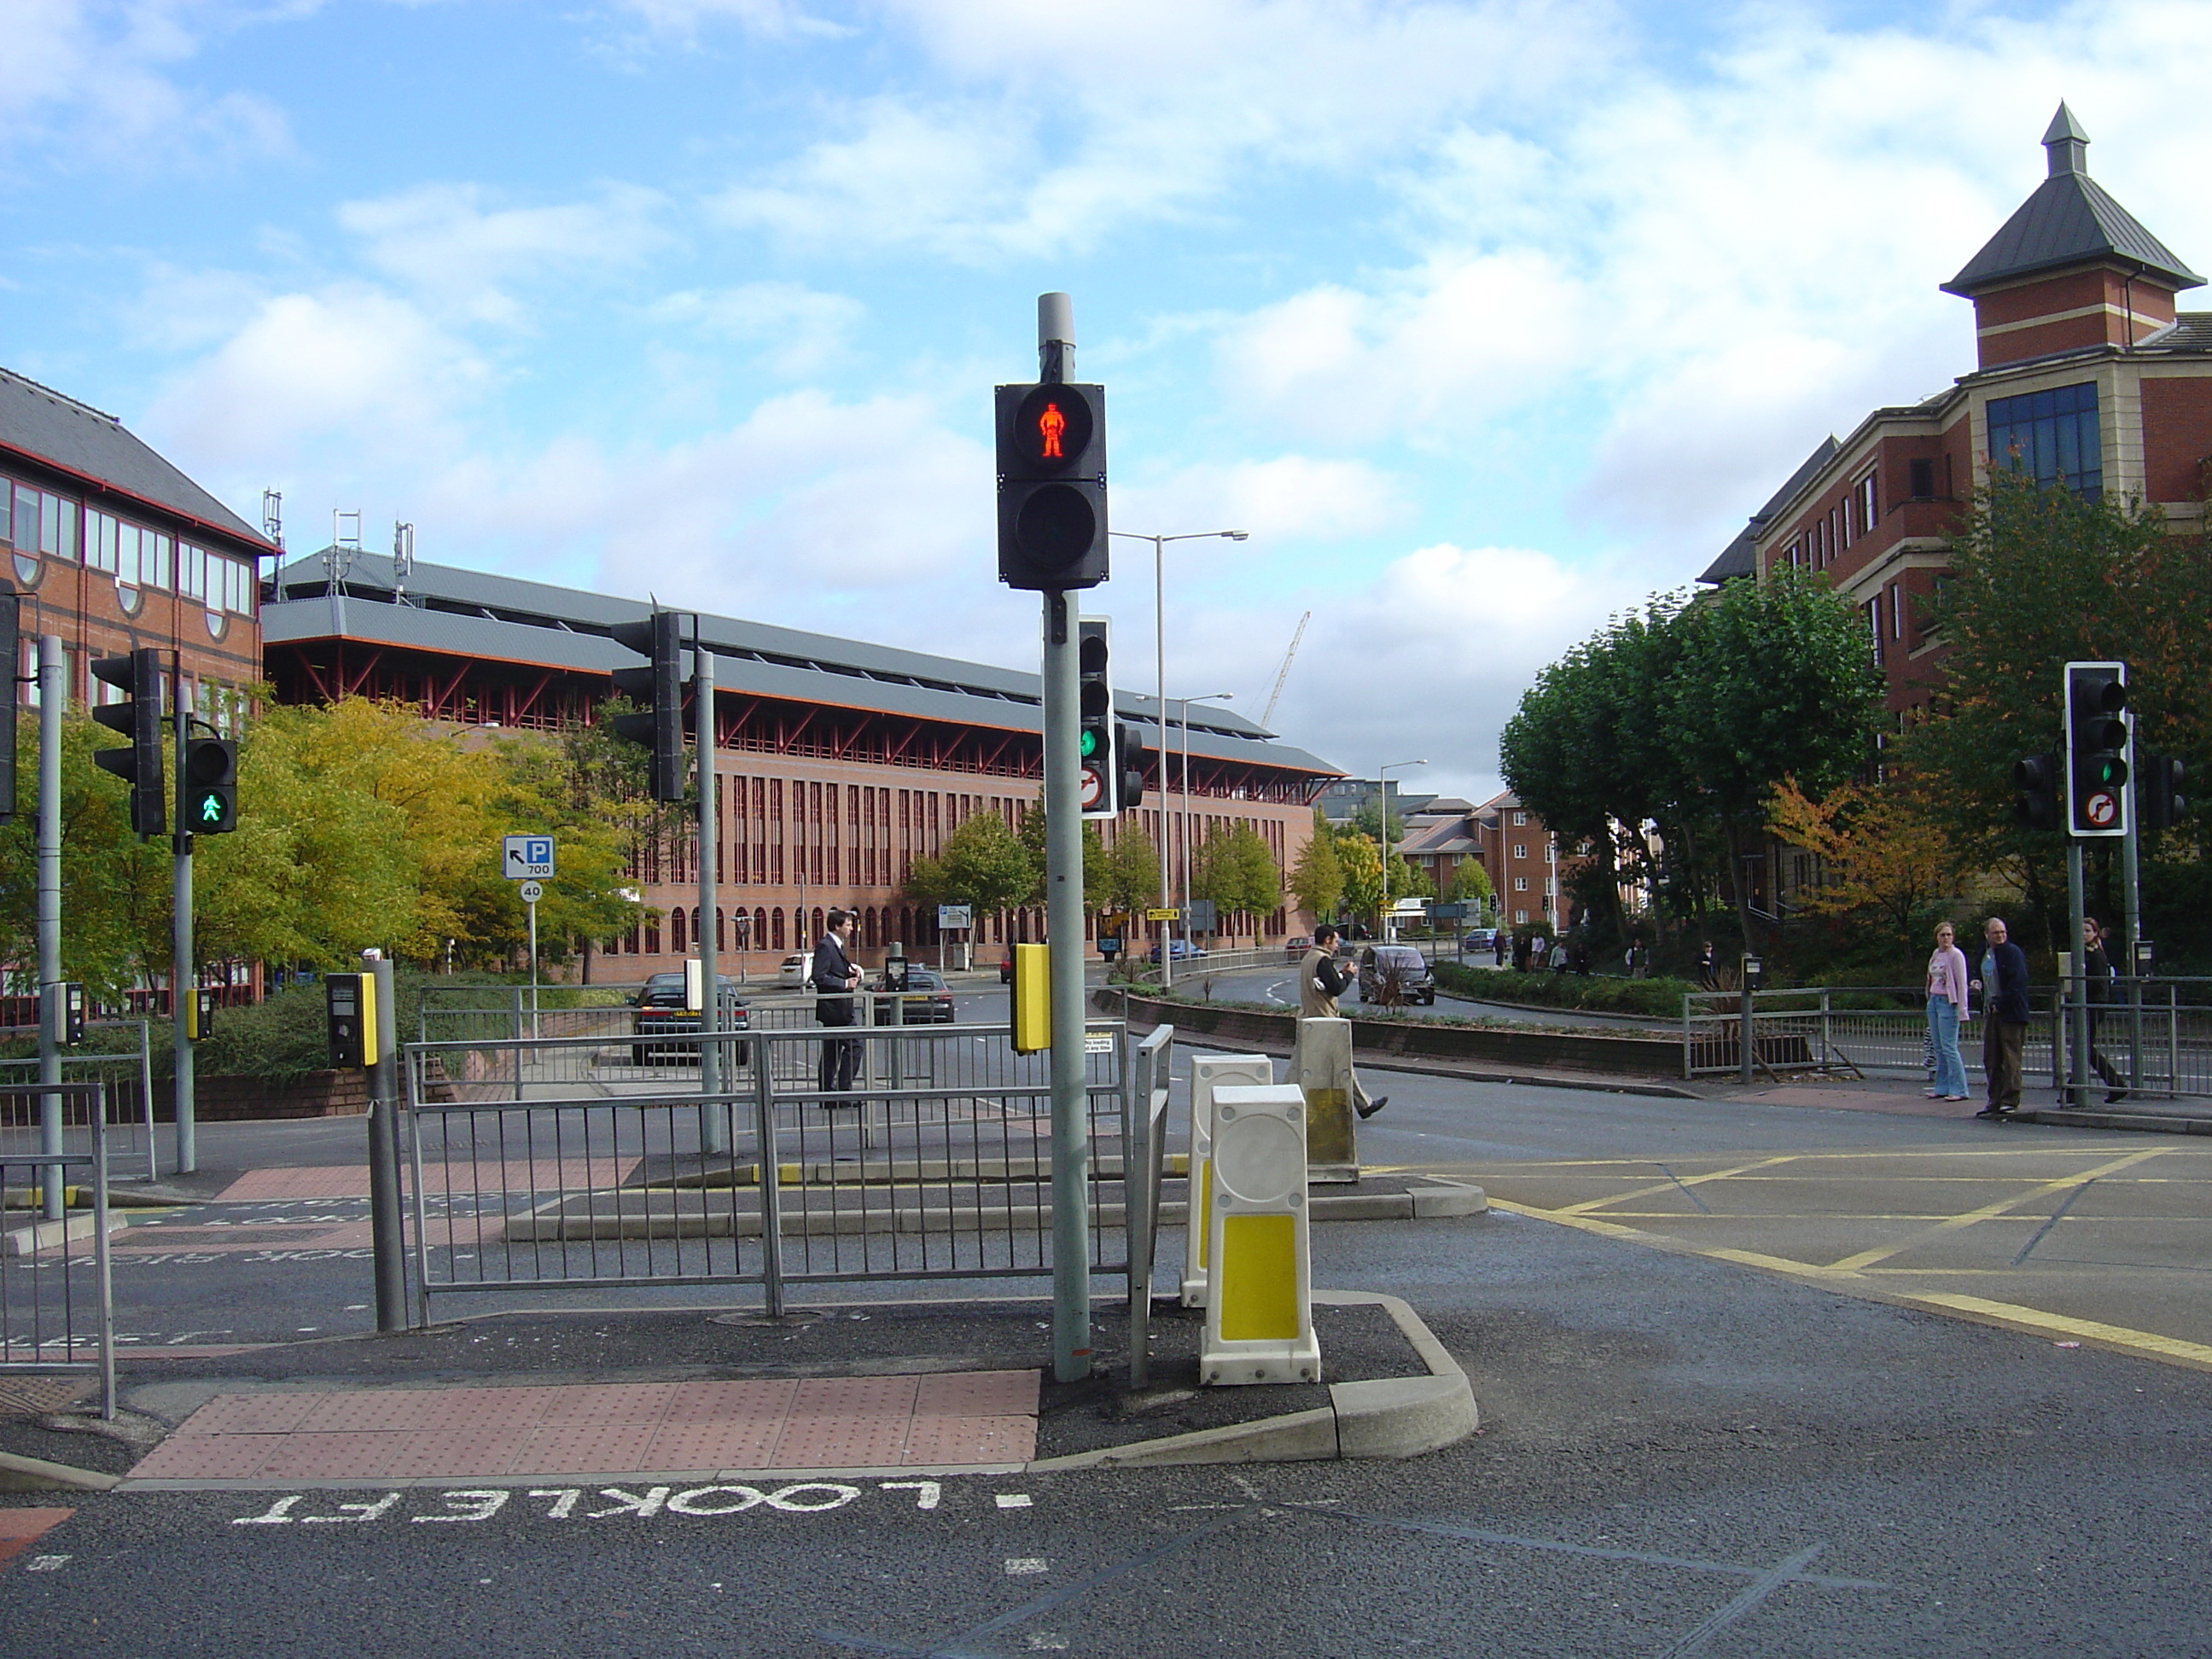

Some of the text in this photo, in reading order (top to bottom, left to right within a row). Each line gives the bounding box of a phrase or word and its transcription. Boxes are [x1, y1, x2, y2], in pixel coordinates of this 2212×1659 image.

[532, 843, 546, 862] P
[528, 865, 550, 874] 700
[524, 888, 540, 896] 40
[231, 1481, 940, 1525] LOOK LEFT
